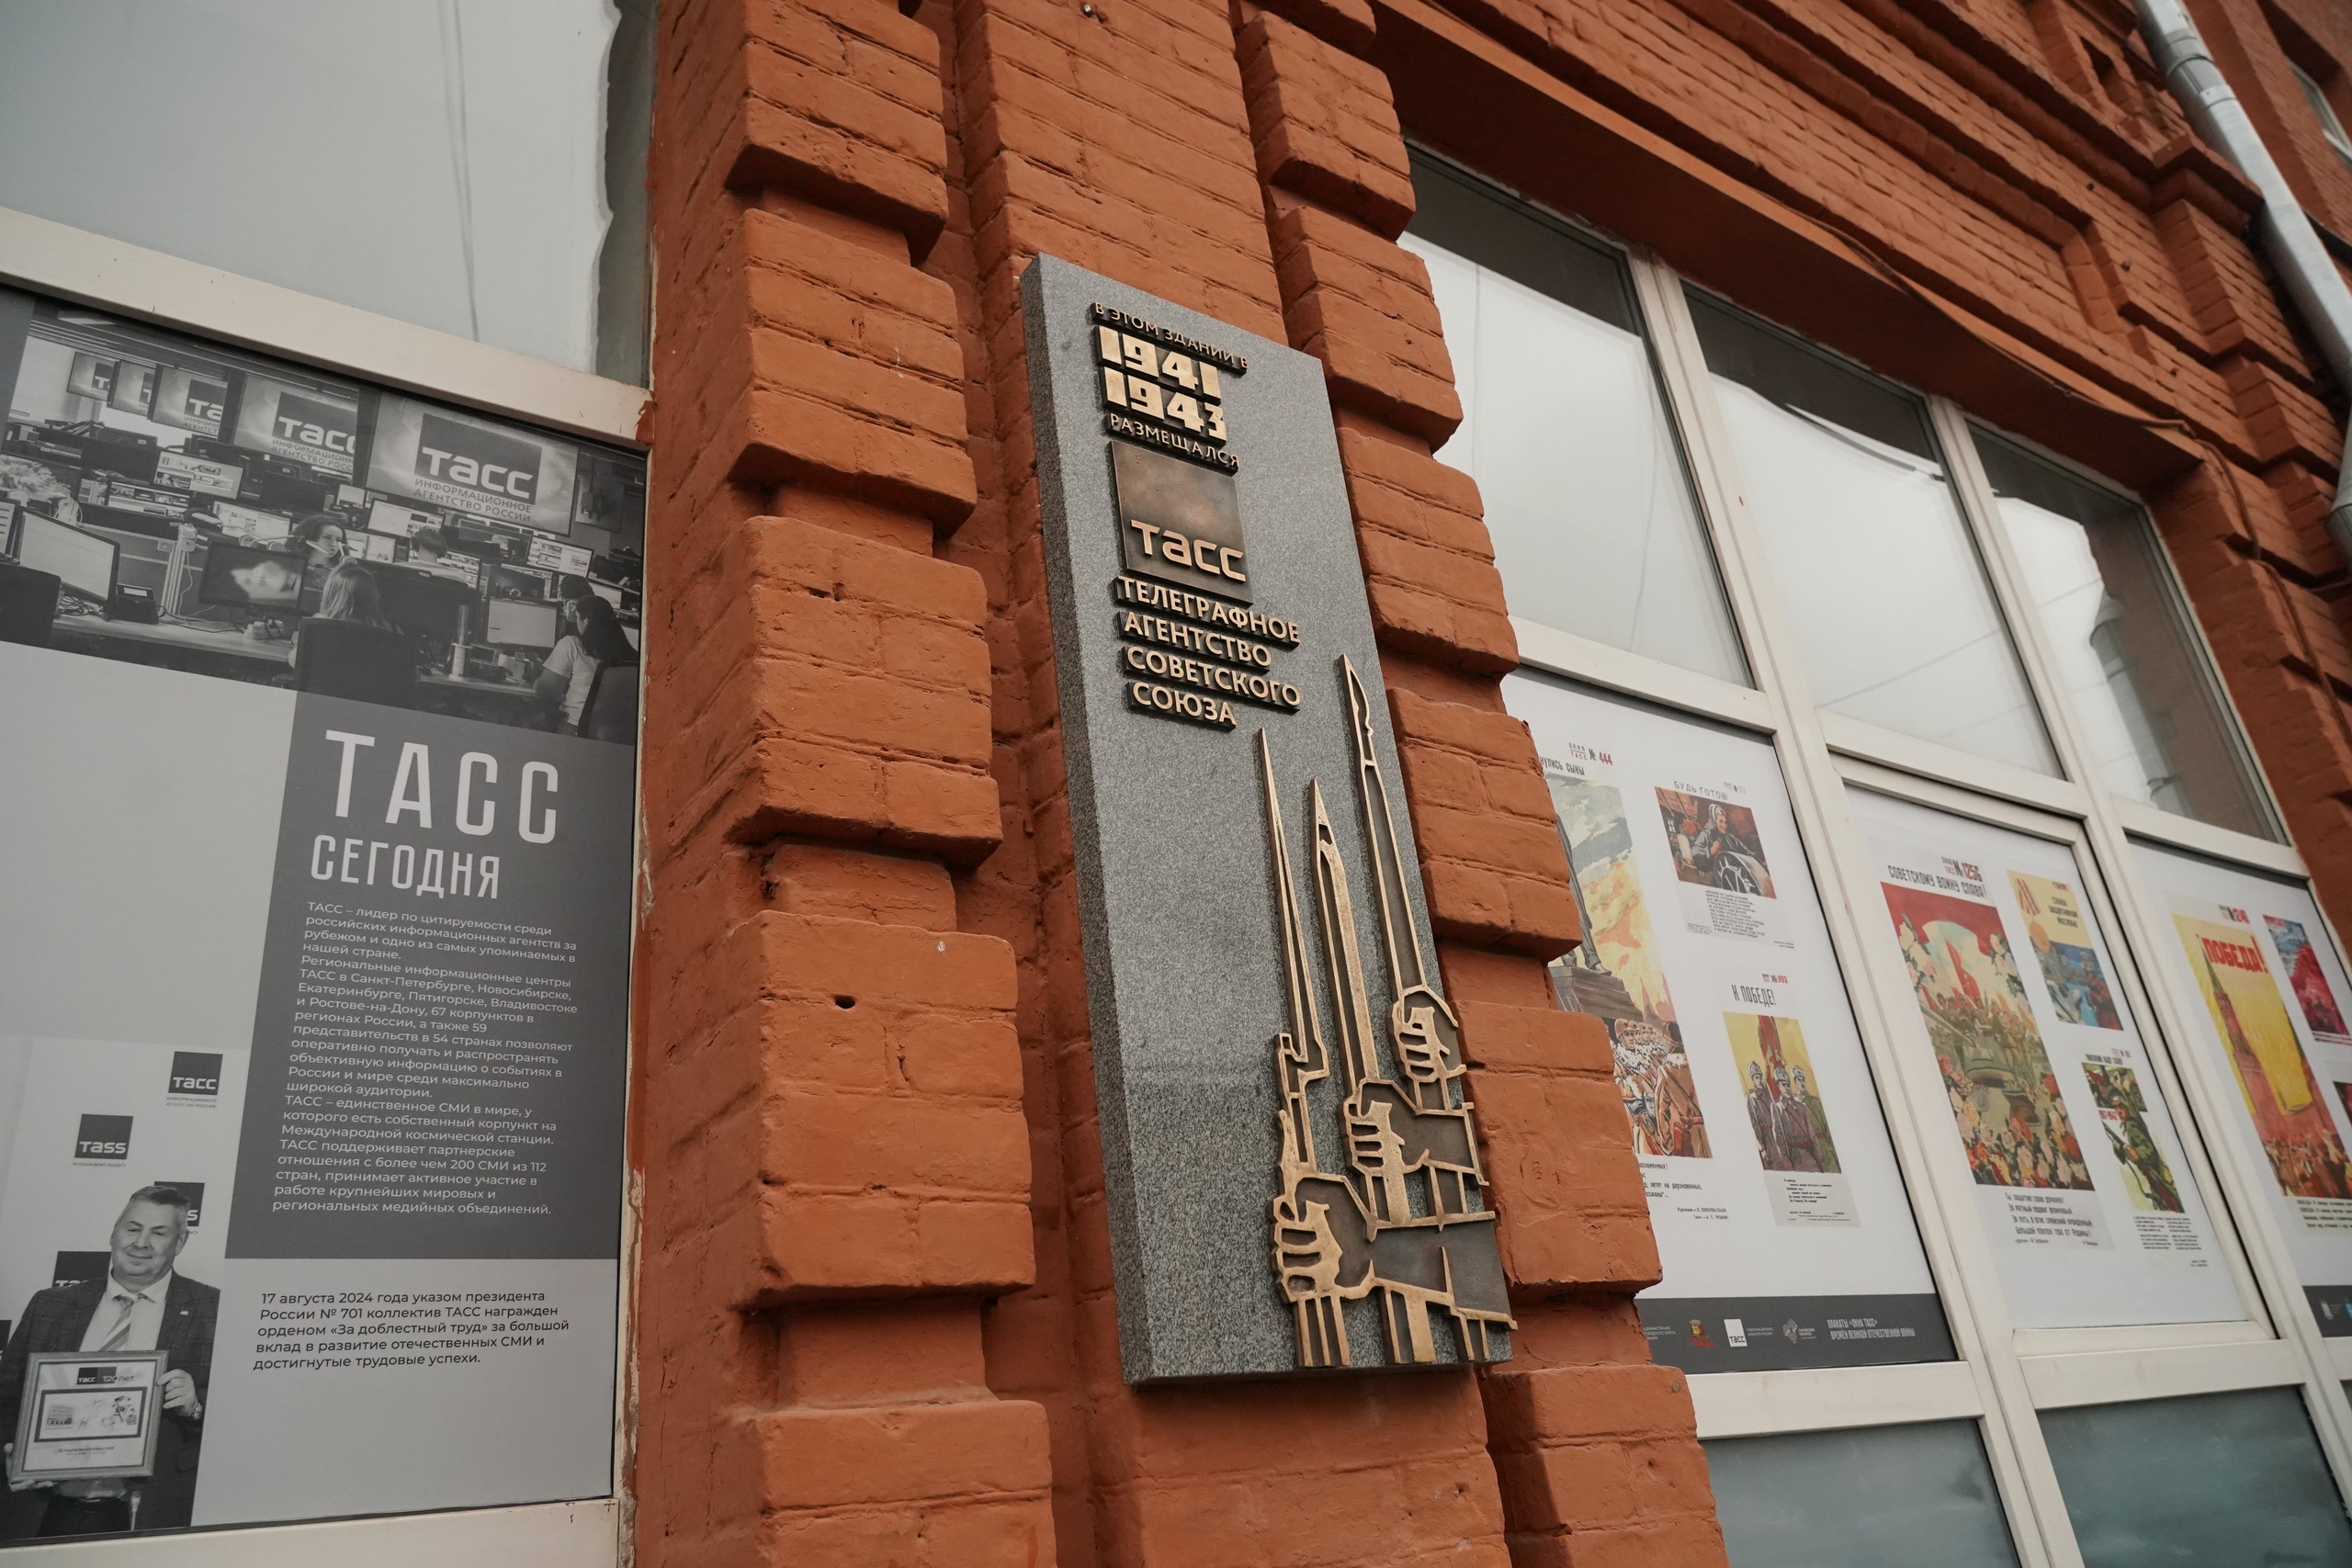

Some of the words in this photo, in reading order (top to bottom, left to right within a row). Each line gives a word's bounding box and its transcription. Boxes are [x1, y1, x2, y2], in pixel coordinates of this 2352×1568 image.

[1095, 301, 1104, 315] В
[1110, 308, 1159, 335] ЭТОМ
[1165, 329, 1235, 365] ЗДАНИИ
[1240, 356, 1249, 368] В
[1099, 325, 1222, 400] 1941
[1104, 366, 1227, 443] 1943
[272, 439, 353, 463] ИНФОРМАЦИОНН
[1110, 413, 1240, 467] РАЗМЕЩАЛСЯ
[271, 447, 325, 465] АГЕНТСТВО
[328, 459, 353, 471] РОСС
[413, 489, 481, 511] АГЕНТСТВО
[485, 505, 531, 523] РОССИИ
[415, 479, 532, 513] ИНФОРМАЦИОННОЕ
[1117, 575, 1301, 644] ТЕЛЕГРАФНОЕ
[1125, 612, 1272, 667] АГЕНТСТВО
[1127, 646, 1301, 706] СОВЕТСКОГО
[1133, 682, 1237, 726] СОЮЗА
[1540, 756, 1563, 771] НУЛИСЬ
[1599, 751, 1612, 765] 444
[325, 729, 559, 844] ТАСС
[1674, 781, 1697, 793] БУДЬ
[311, 834, 500, 899] СЕГОДНЯ
[307, 901, 344, 914] ТАСС
[355, 908, 399, 921] лидер
[401, 913, 418, 922] по
[421, 915, 512, 931] цитируемости
[514, 925, 552, 936] среди
[303, 930, 367, 943] рубежом
[369, 936, 379, 944] и
[381, 937, 415, 948] одно
[418, 941, 434, 950] из
[435, 942, 477, 953] самых
[479, 946, 566, 962] упоминаемых
[568, 954, 576, 963] в
[305, 917, 387, 931] российских
[390, 924, 506, 943] информационных
[508, 937, 561, 949] агентств
[563, 942, 577, 951] за
[302, 943, 349, 954] нашей
[352, 948, 401, 960] стране.
[2201, 936, 2268, 975] ПОБЕДА!
[300, 954, 401, 973] Региональные
[404, 965, 523, 984] информационные
[525, 976, 571, 988] центры
[300, 968, 336, 981] ТАСС
[339, 974, 347, 982] в
[350, 973, 474, 994] Санкт-Петербурге,
[477, 984, 571, 1001] Новосибирске,
[1731, 985, 1740, 1001] К
[1740, 986, 1777, 1008] ПОБЕДЕ!
[298, 982, 405, 1001] Екатеринбурге,
[408, 990, 488, 1008] Пятигорске,
[491, 998, 578, 1013] Владивостоке
[294, 1011, 361, 1024] регионах
[364, 1014, 416, 1030] России,
[419, 1021, 427, 1029] а
[430, 1021, 469, 1032] также
[471, 1022, 488, 1032] 59
[292, 1025, 419, 1042] представительств
[422, 1034, 430, 1043] в
[432, 1033, 449, 1043] 54
[451, 1036, 503, 1047] странах
[505, 1040, 573, 1052] позволяют
[290, 1039, 377, 1053] оперативно
[379, 1045, 441, 1057] получать
[443, 1049, 452, 1057] и
[455, 1050, 559, 1065] распространять
[286, 1082, 353, 1094] широкой
[356, 1086, 433, 1099] аудитории.
[283, 1111, 348, 1123] которого
[351, 1114, 382, 1124] есть
[384, 1114, 475, 1127] собственный
[478, 1120, 539, 1132] корпункт
[541, 1122, 557, 1131] на
[281, 1124, 402, 1139] Международной
[405, 1131, 494, 1142] космической
[497, 1134, 554, 1145] станции.
[279, 1138, 318, 1151] ТАСС
[321, 1142, 426, 1155] поддерживает
[428, 1145, 515, 1158] партнерские
[277, 1156, 360, 1167] отношения
[363, 1158, 372, 1168] с
[375, 1156, 418, 1168] более
[420, 1160, 447, 1169] чем
[449, 1159, 475, 1170] 200
[478, 1160, 509, 1171] СМИ
[513, 1163, 528, 1172] из
[530, 1161, 548, 1172] 112
[275, 1170, 322, 1182] стран,
[324, 1172, 406, 1183] принимает
[407, 1174, 472, 1184] активное
[474, 1176, 527, 1187] участие
[529, 1178, 537, 1186] в
[274, 1183, 326, 1197] работе
[329, 1186, 420, 1199] крупнейших
[423, 1190, 484, 1201] мировых
[487, 1190, 496, 1199] и
[272, 1201, 379, 1213] региональных
[381, 1201, 455, 1213] медийных
[457, 1201, 551, 1215] объединений.
[261, 1292, 277, 1304] 17
[279, 1294, 335, 1306] августа
[338, 1292, 374, 1303] 2024
[377, 1293, 409, 1304] года
[412, 1293, 462, 1305] указом
[465, 1292, 546, 1303] президента
[260, 1309, 316, 1320] России
[320, 1308, 337, 1319] №
[340, 1307, 363, 1319] 701
[367, 1309, 442, 1319] коллектив
[445, 1306, 481, 1317] ТАСС
[484, 1307, 559, 1318] награжден
[257, 1326, 326, 1338] орденом
[330, 1324, 355, 1336] «За
[357, 1322, 447, 1336] доблестный
[449, 1324, 488, 1335] труд»
[491, 1323, 506, 1332] за
[509, 1319, 570, 1332] большой
[255, 1343, 301, 1354] вклад
[305, 1342, 314, 1352] в
[318, 1341, 388, 1354] развитие
[390, 1338, 498, 1349] отечественных
[500, 1336, 533, 1347] СМИ
[536, 1337, 545, 1346] и
[253, 1358, 352, 1371] достигнутые
[355, 1356, 425, 1369] трудовые
[427, 1354, 481, 1367] успехи.
